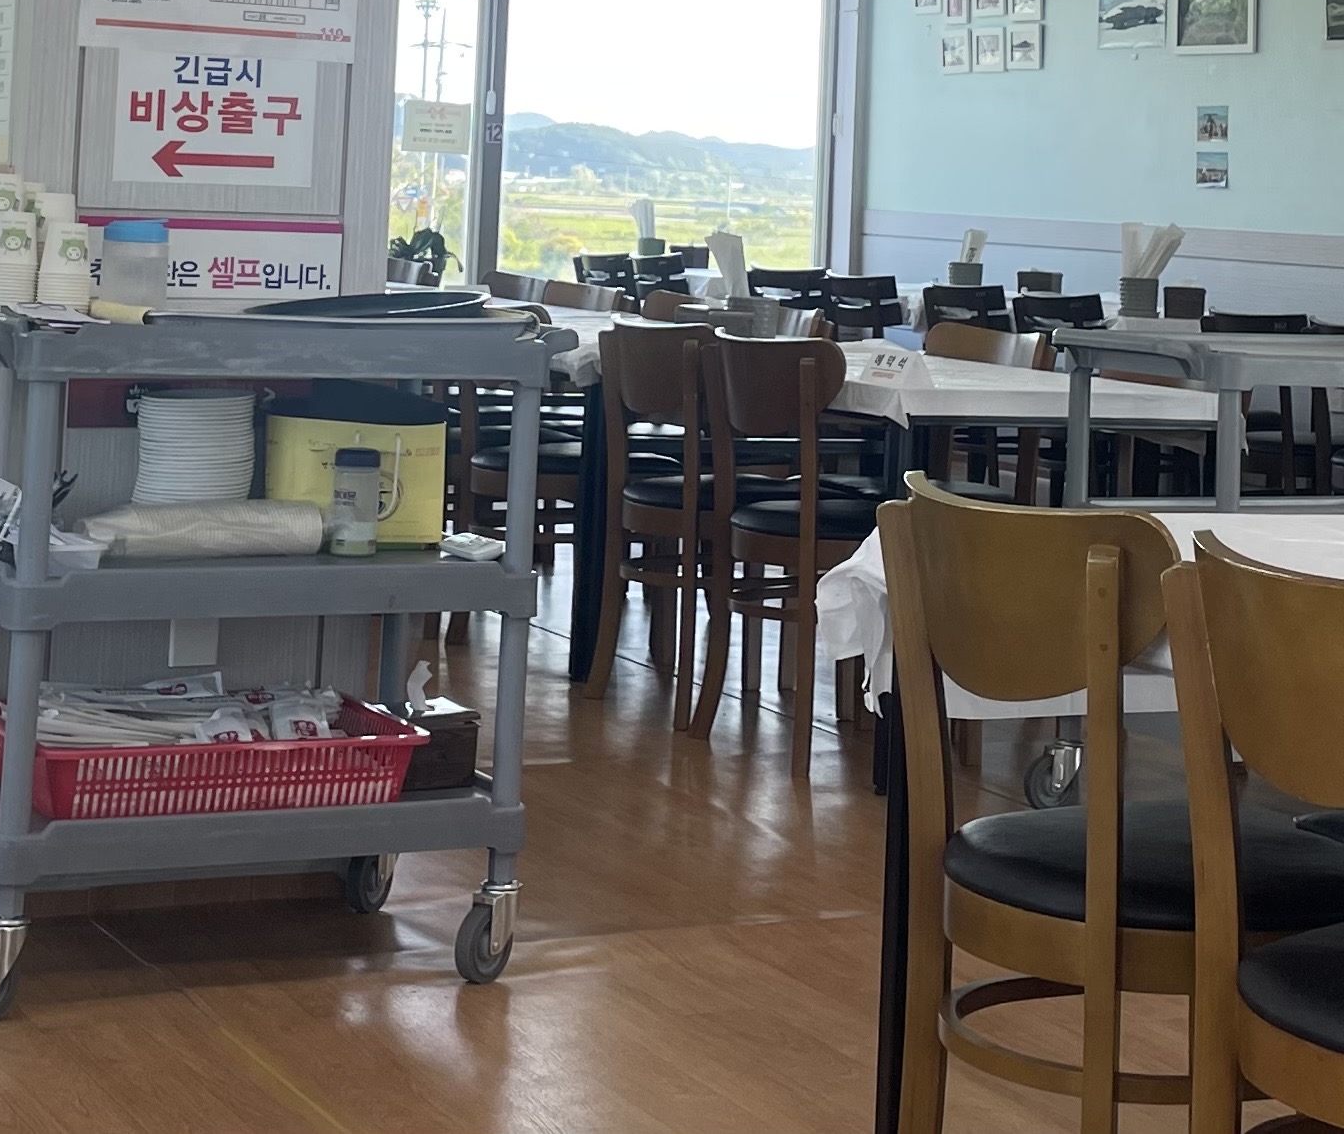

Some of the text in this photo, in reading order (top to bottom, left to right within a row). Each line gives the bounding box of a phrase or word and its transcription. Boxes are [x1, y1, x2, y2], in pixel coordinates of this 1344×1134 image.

[321, 28, 344, 41] 119
[173, 55, 262, 88] 긴급시
[129, 89, 302, 136] 비상출구
[486, 124, 502, 142] 12
[208, 257, 331, 290] 셀프입니다.
